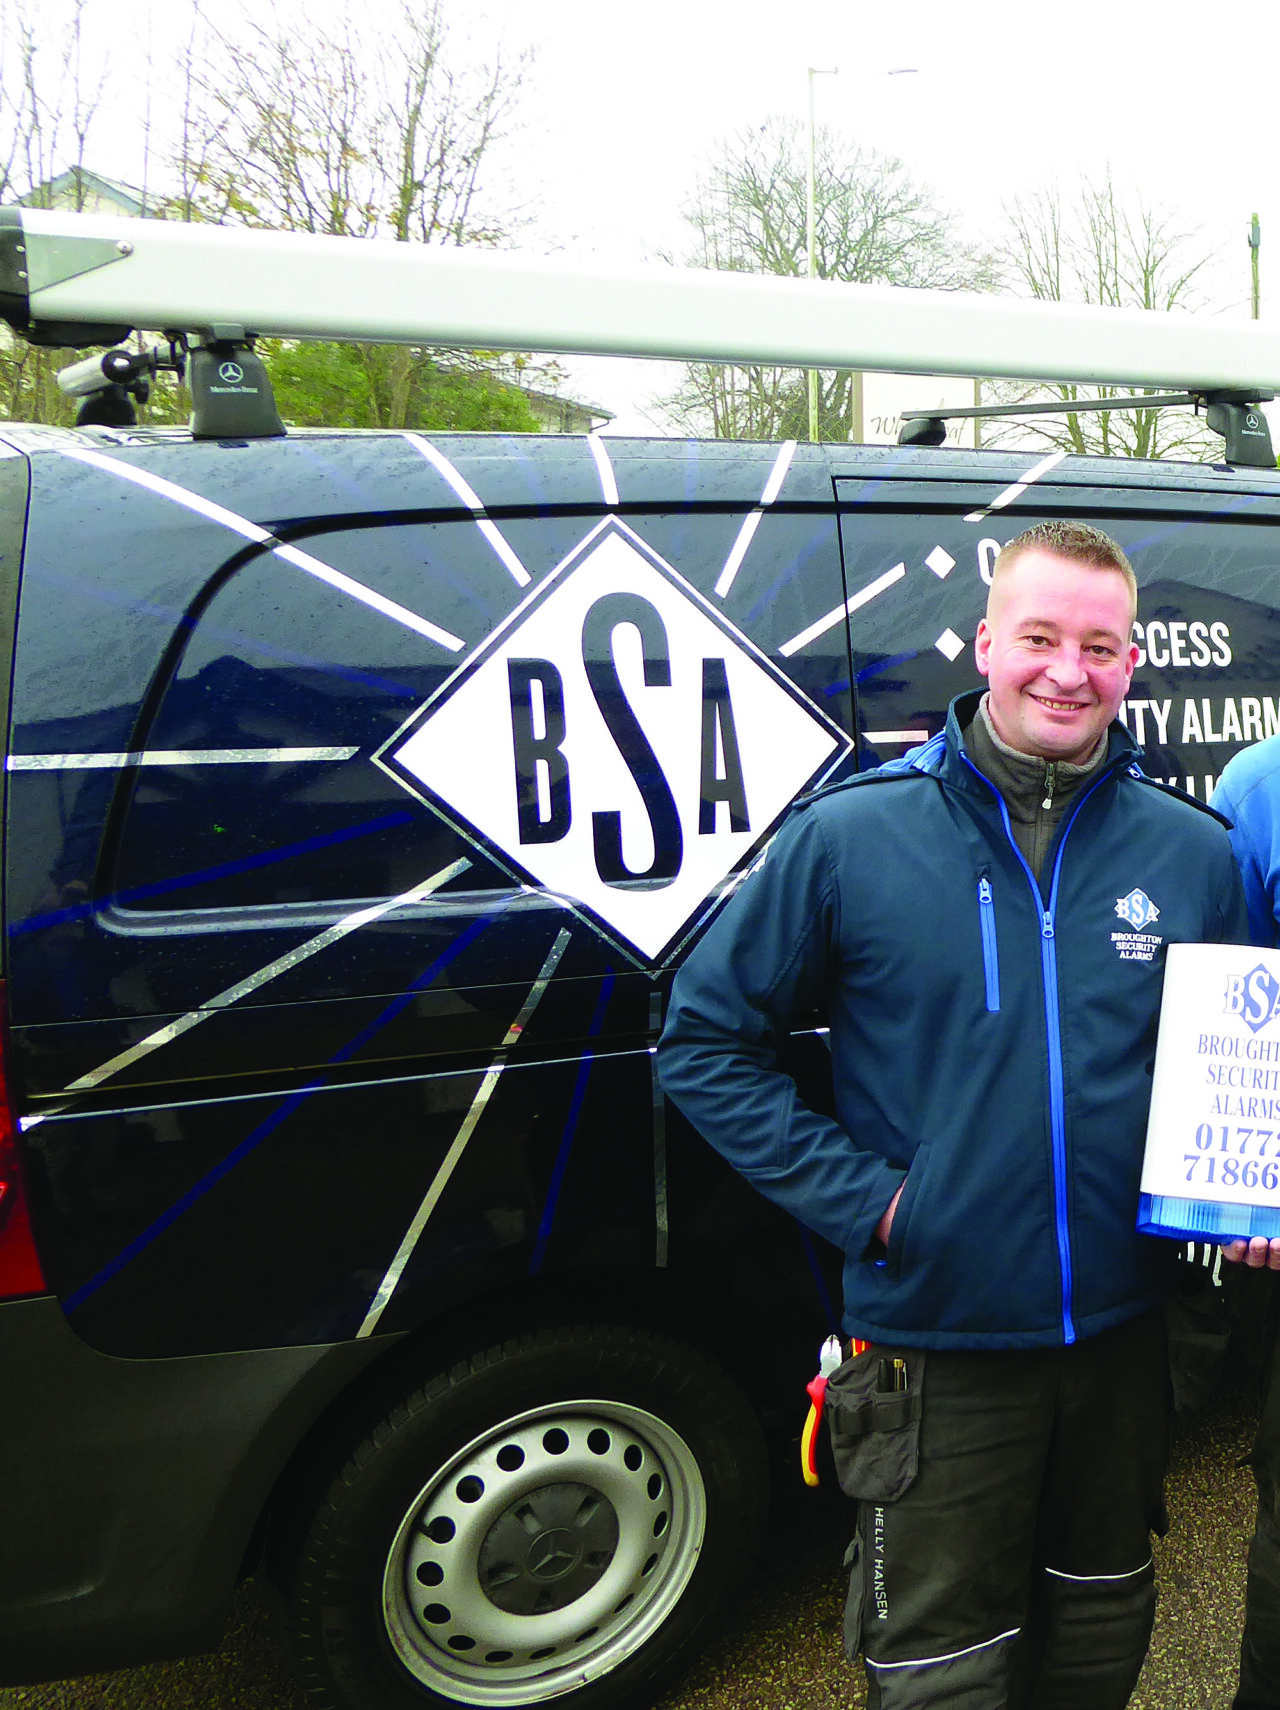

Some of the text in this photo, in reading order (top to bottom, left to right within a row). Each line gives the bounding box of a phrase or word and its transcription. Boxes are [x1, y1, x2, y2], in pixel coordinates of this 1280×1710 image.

[1132, 621, 1232, 668] CCESS
[507, 592, 751, 892] BSA
[1116, 893, 1159, 924] BSA
[1110, 932, 1163, 944] BROUGHTON
[1115, 941, 1157, 952] SECURITY
[1119, 951, 1154, 960] ALARMS
[874, 1507, 888, 1619] HELLY HANSEN
